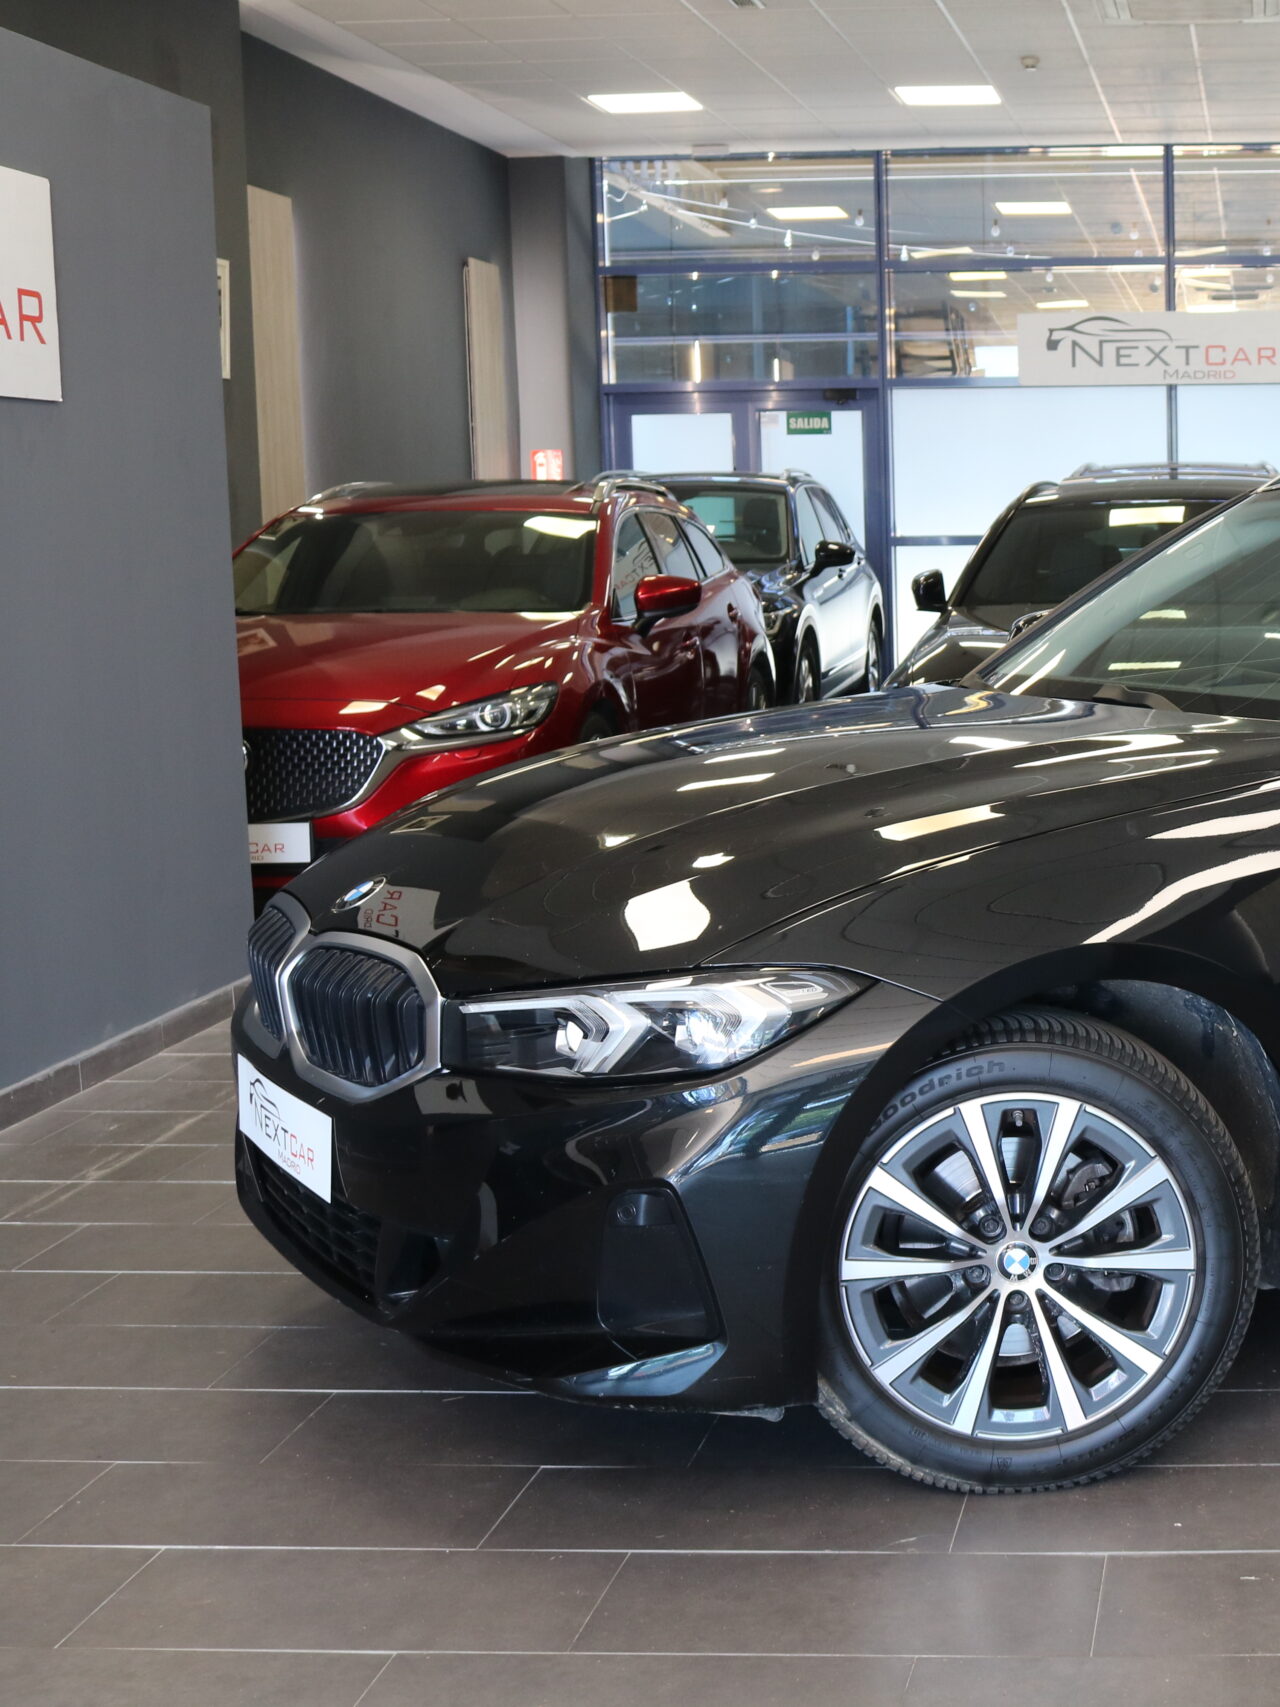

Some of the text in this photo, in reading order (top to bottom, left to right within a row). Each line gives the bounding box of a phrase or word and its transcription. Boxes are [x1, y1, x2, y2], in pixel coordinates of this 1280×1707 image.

[1071, 339, 1277, 368] NEXTCAR
[1163, 369, 1236, 380] MADRID
[789, 417, 829, 429] SALIDA
